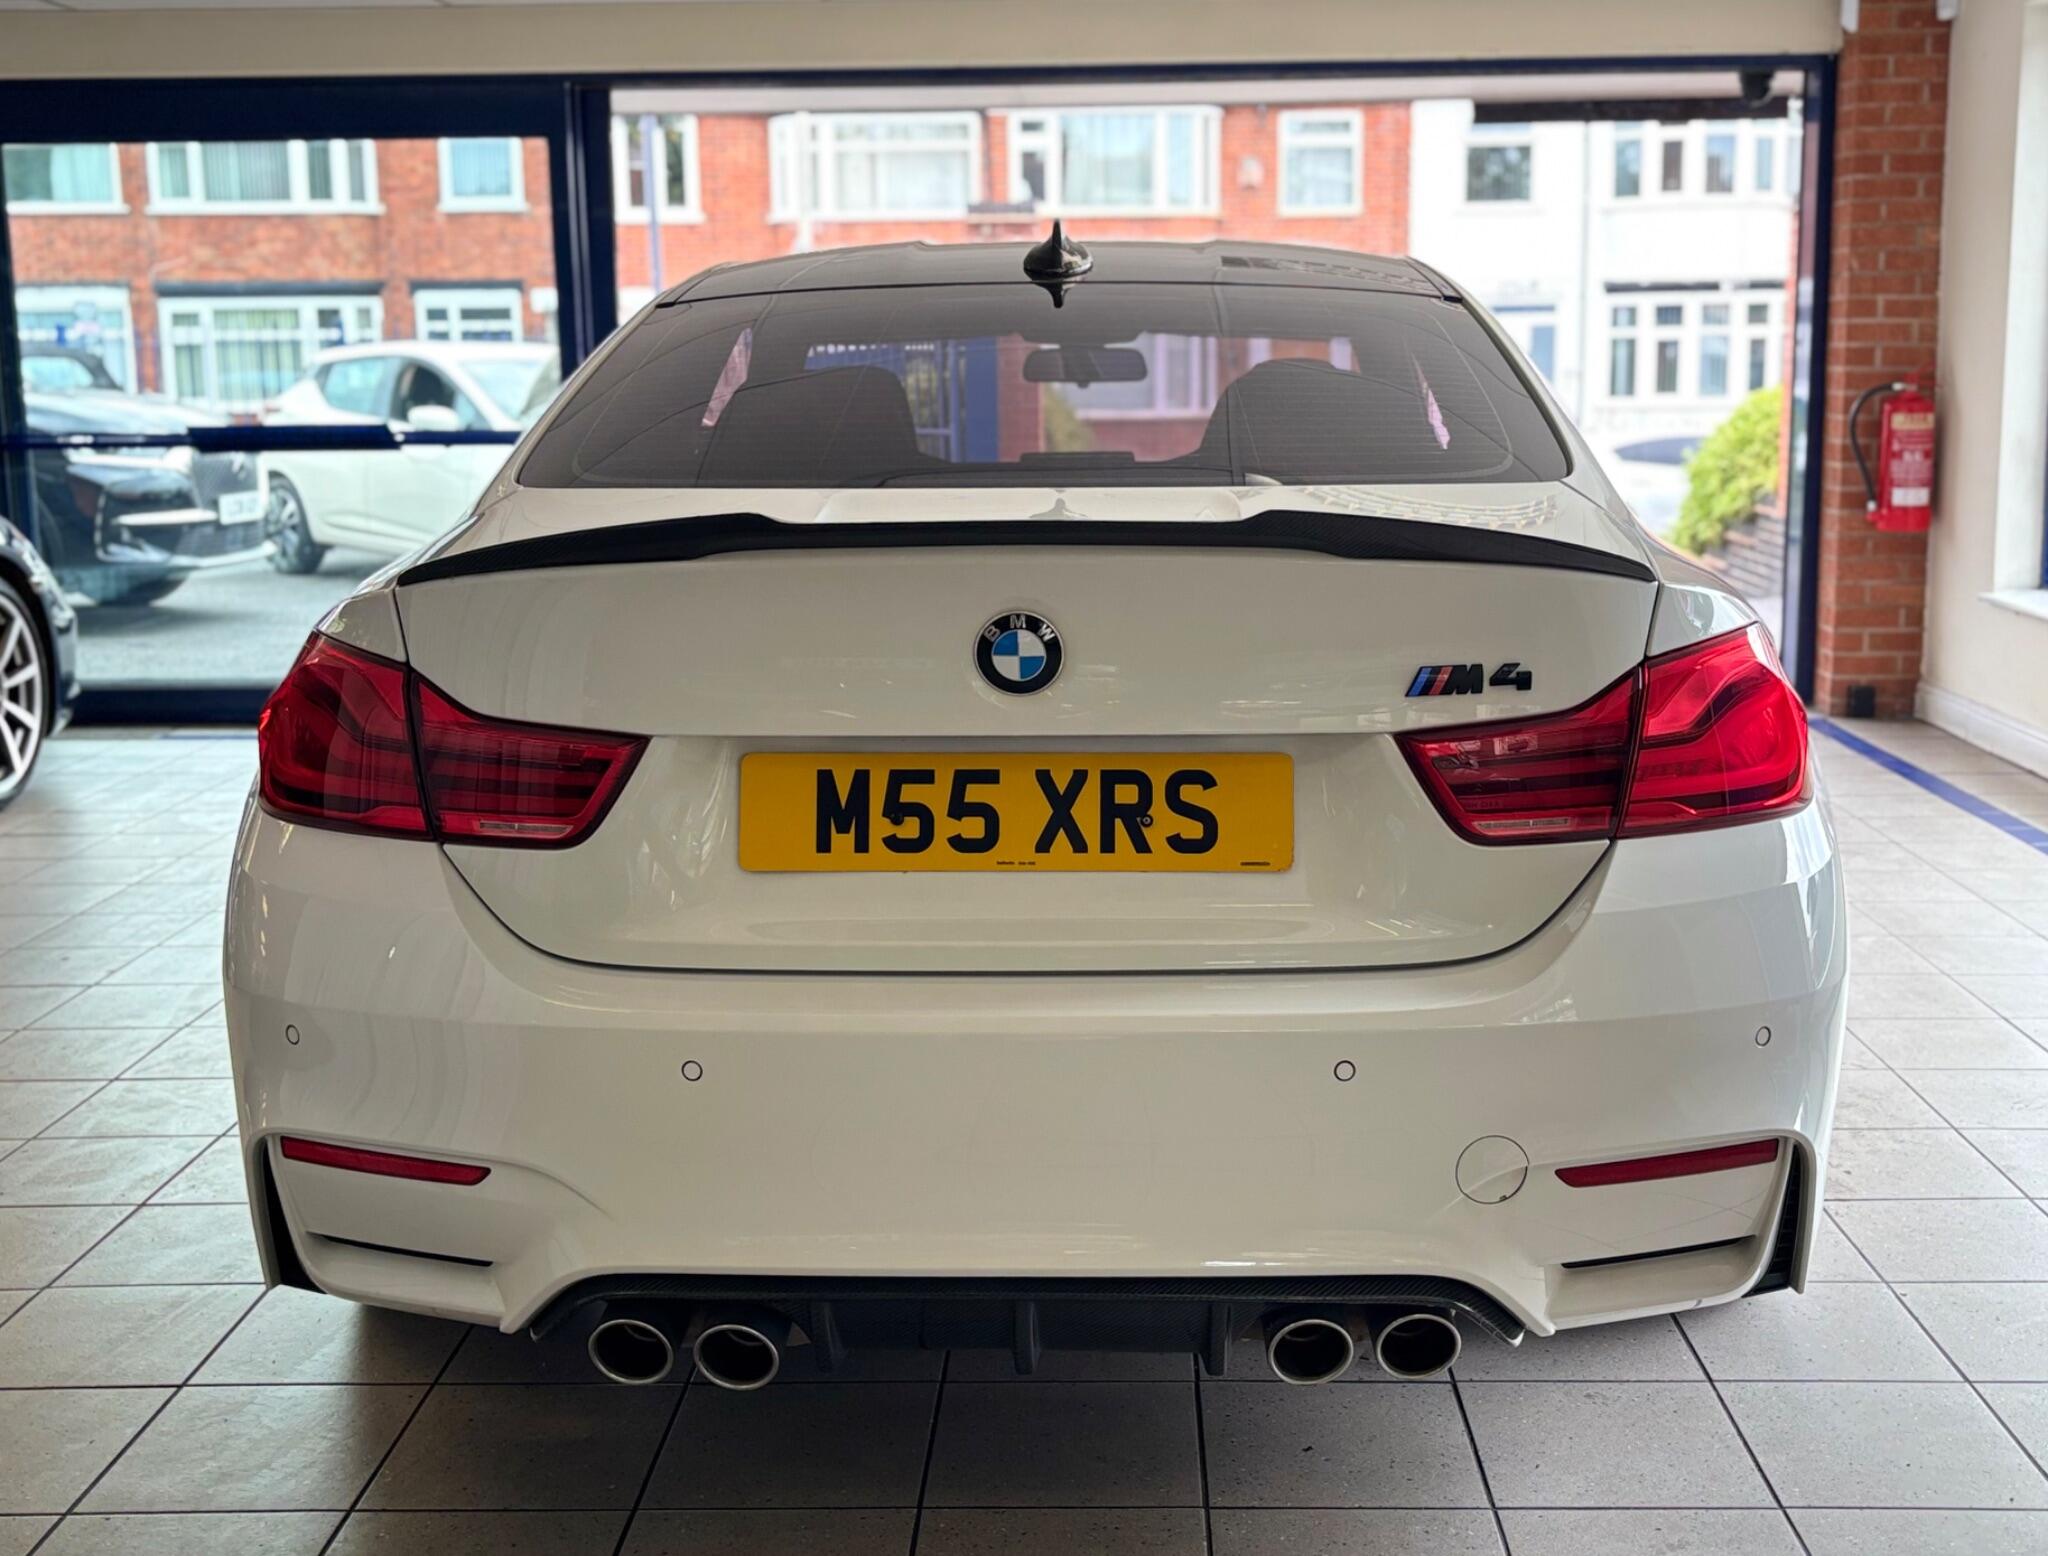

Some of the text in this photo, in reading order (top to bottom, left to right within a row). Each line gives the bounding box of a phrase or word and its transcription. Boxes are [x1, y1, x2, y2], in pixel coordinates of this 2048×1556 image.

[983, 614, 1055, 642] BMW
[815, 768, 1219, 854] M55 XRS
